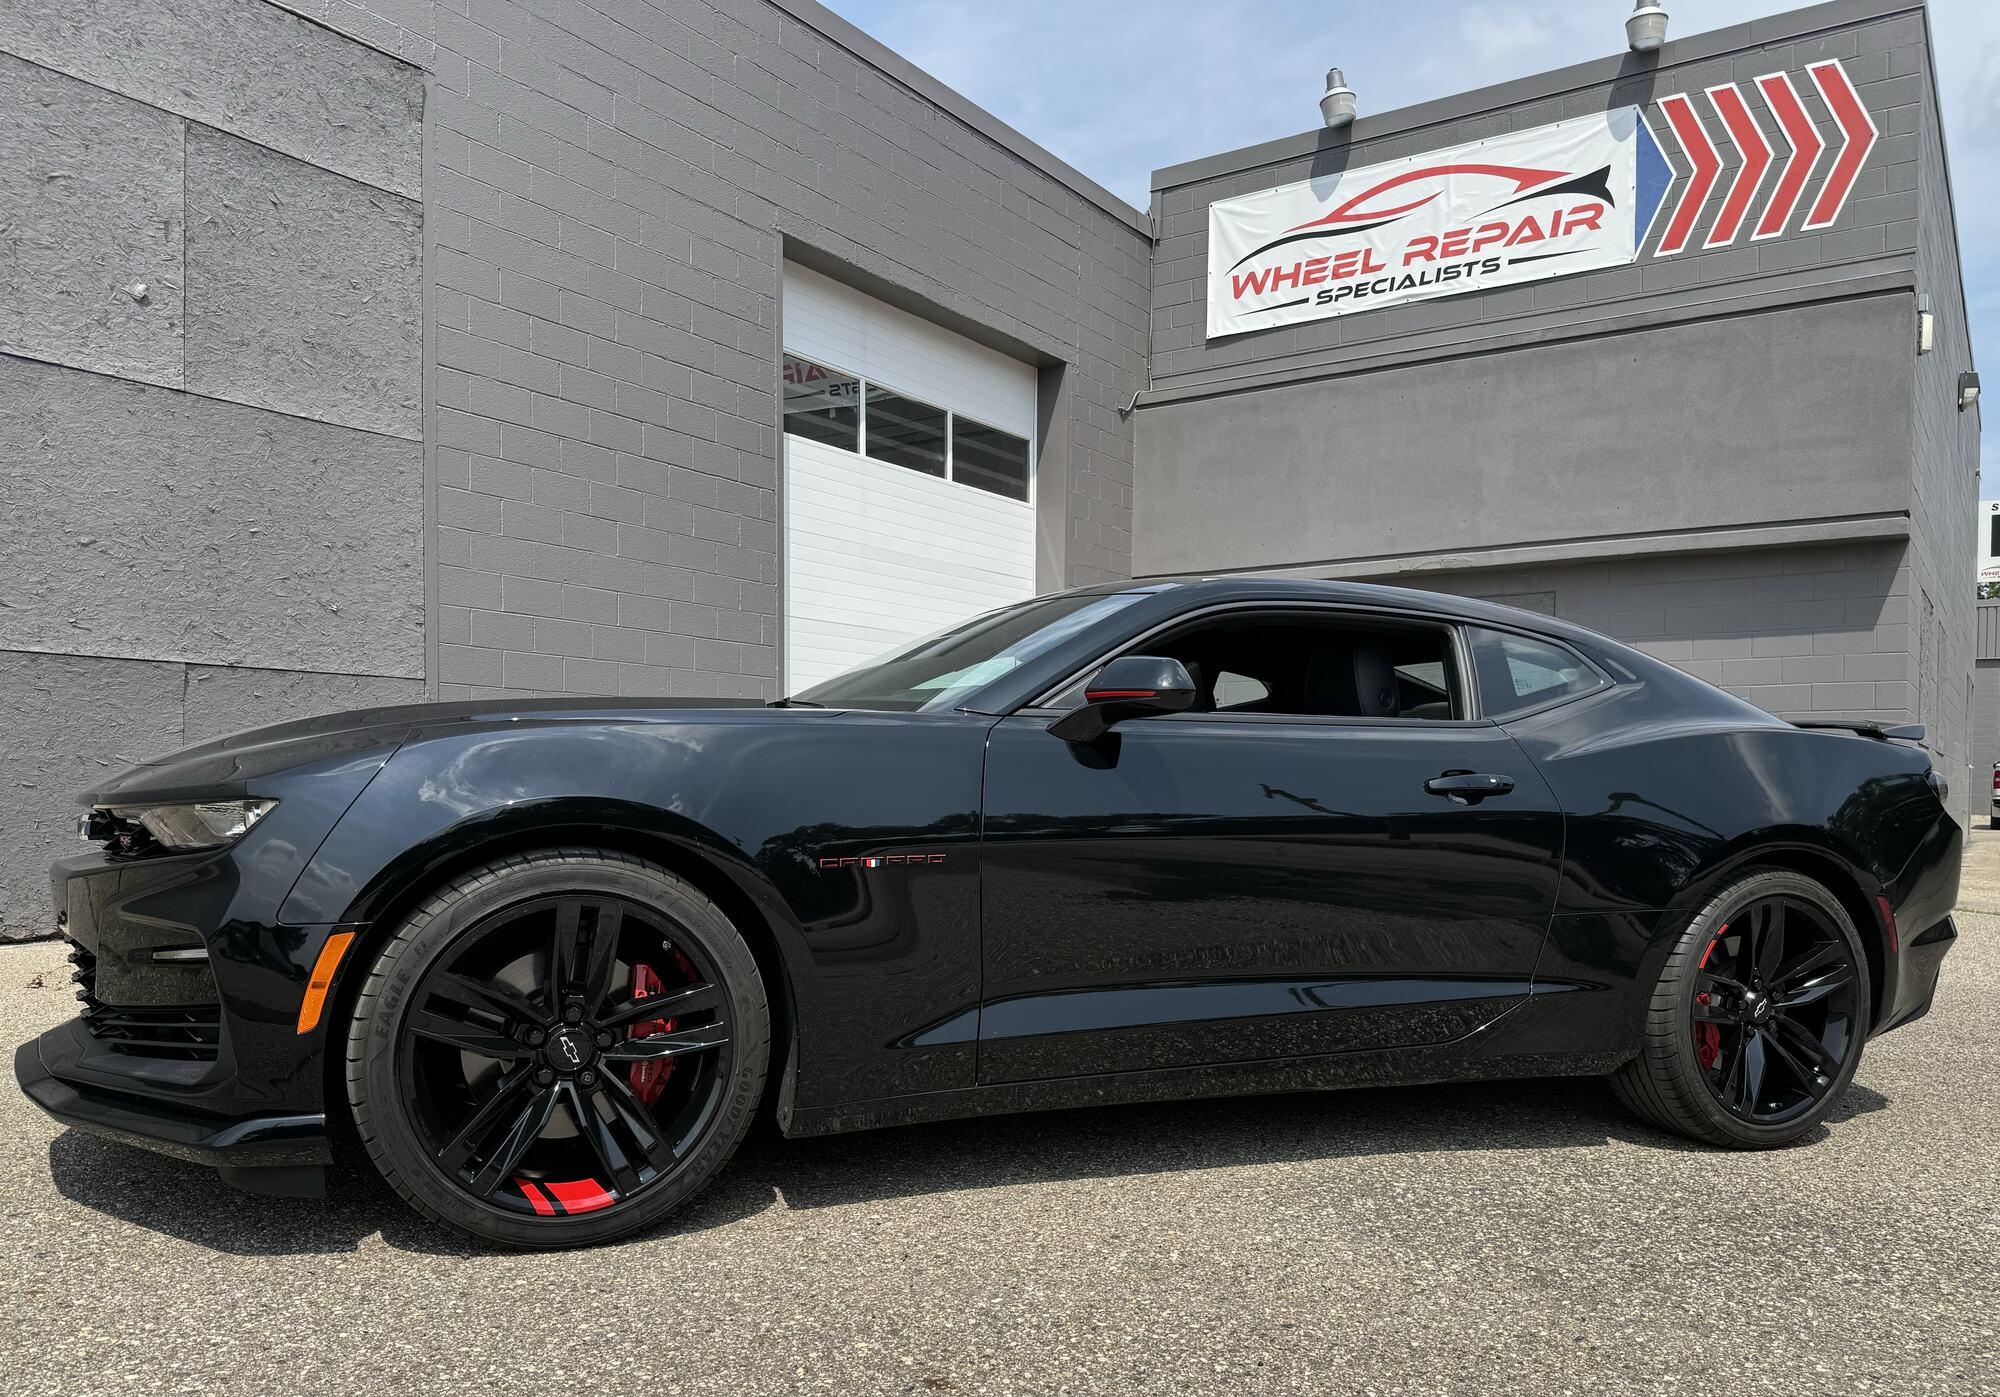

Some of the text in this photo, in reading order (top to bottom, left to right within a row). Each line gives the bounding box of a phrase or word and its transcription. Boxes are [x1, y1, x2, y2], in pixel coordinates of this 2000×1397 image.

[1232, 202, 1605, 300] WHEEL REPAIR
[1314, 256, 1501, 306] SPECIALISTS
[374, 968, 412, 1039] EAGLE
[692, 1066, 753, 1177] GOODYEAR
